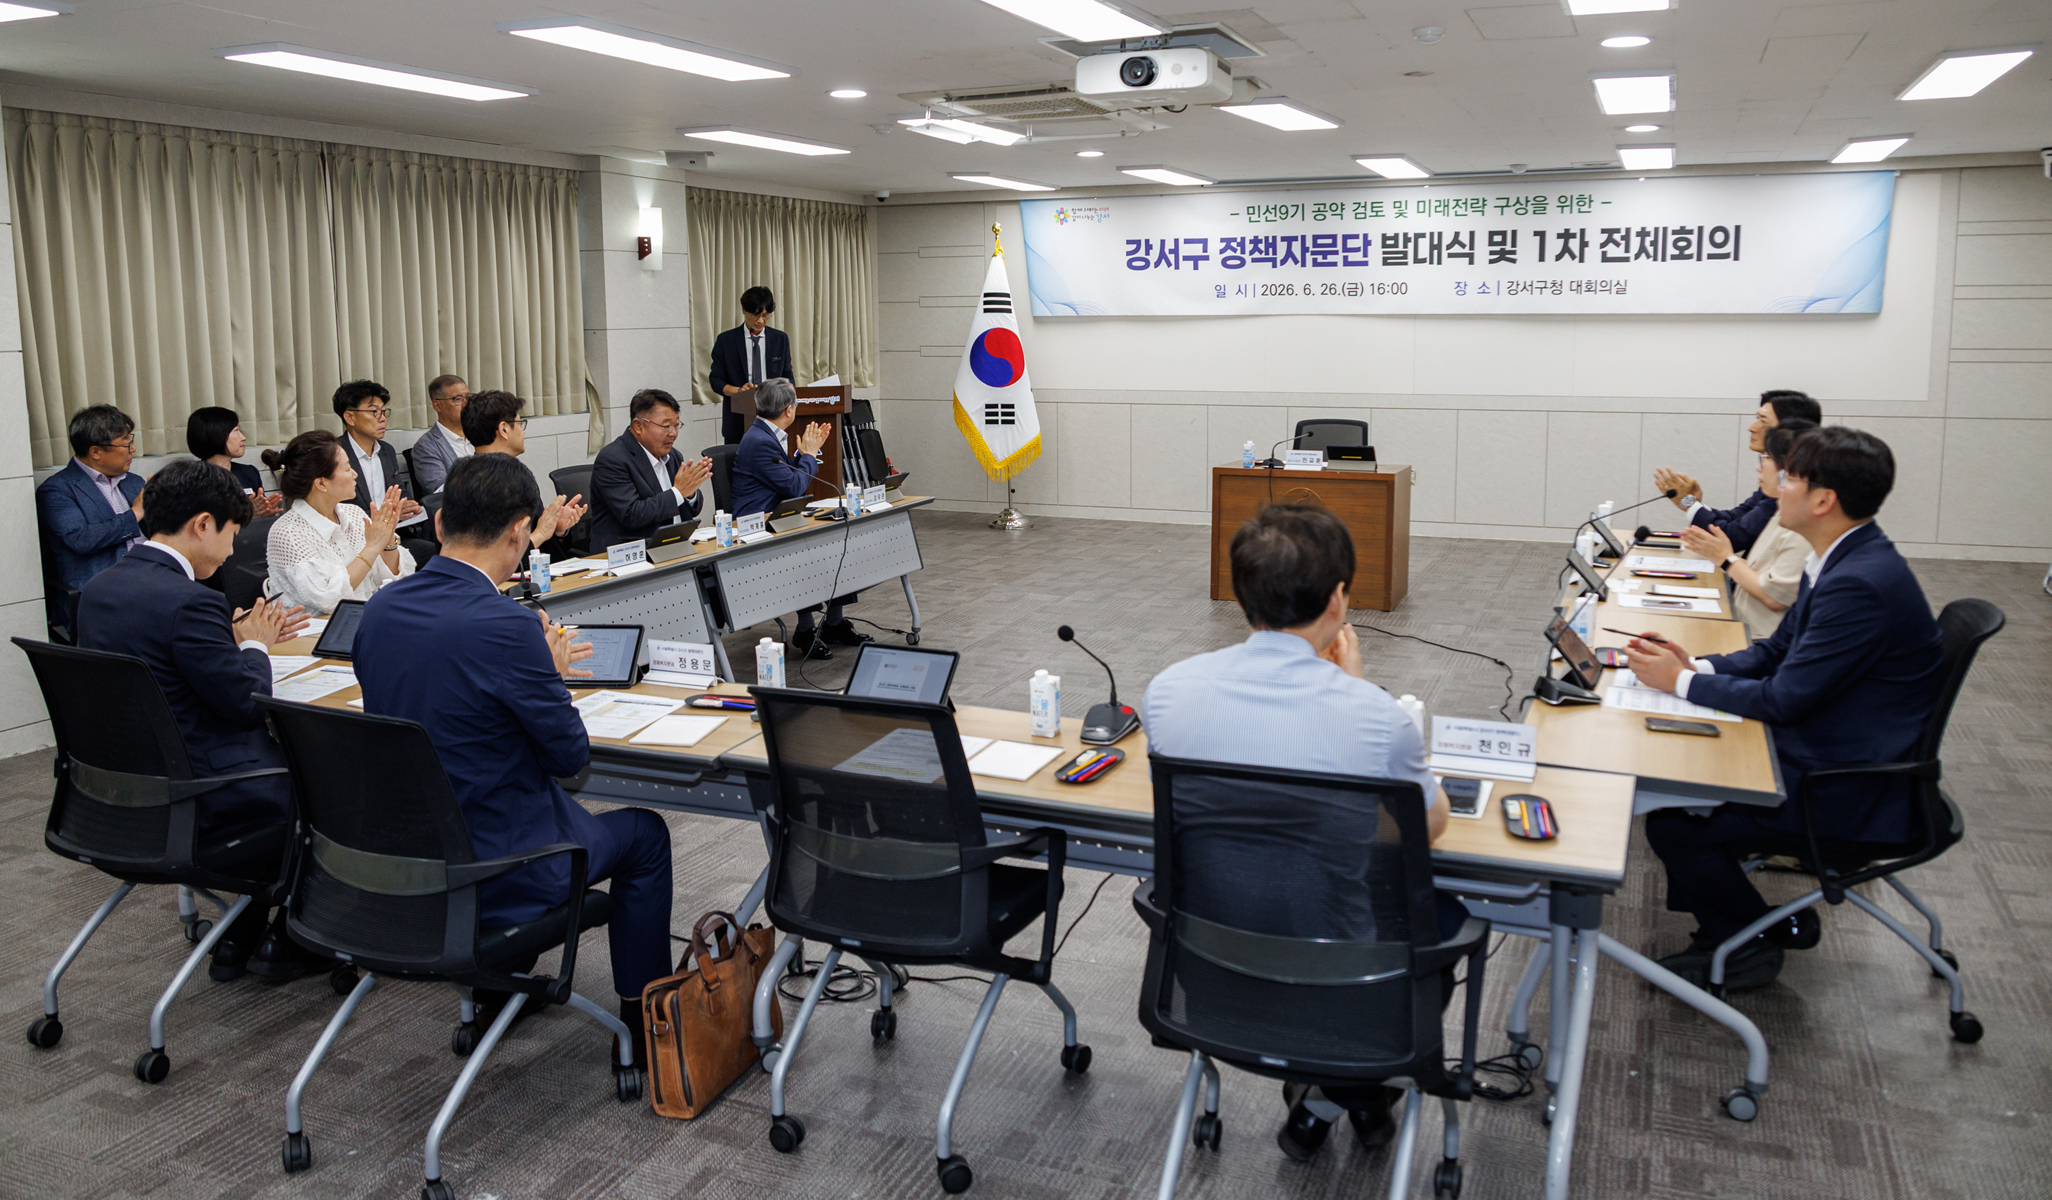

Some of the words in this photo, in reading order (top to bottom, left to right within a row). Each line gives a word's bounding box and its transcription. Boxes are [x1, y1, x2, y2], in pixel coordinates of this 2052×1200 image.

[1247, 203, 1305, 223] 민선9기
[1312, 201, 1346, 221] 공약
[1352, 200, 1386, 220] 검토
[1393, 199, 1408, 219] 및
[1417, 197, 1488, 218] 미래전략
[1494, 195, 1549, 216] 구상을
[1556, 193, 1594, 214] 위한
[1095, 213, 1110, 223] 강서
[1126, 238, 1210, 271] 강서구
[1219, 233, 1372, 270] 정책자문단
[1381, 230, 1476, 266] 발대식
[1488, 229, 1518, 264] 및
[1533, 228, 1590, 263] 1차
[1599, 225, 1742, 263] 전체회의
[1261, 284, 1298, 297] 2026.
[1303, 284, 1315, 296] 6.
[1321, 282, 1364, 297] 26.(금)
[1370, 282, 1408, 296] 16:00
[1507, 280, 1563, 296] 강서구청
[1570, 280, 1628, 296] 대회의실
